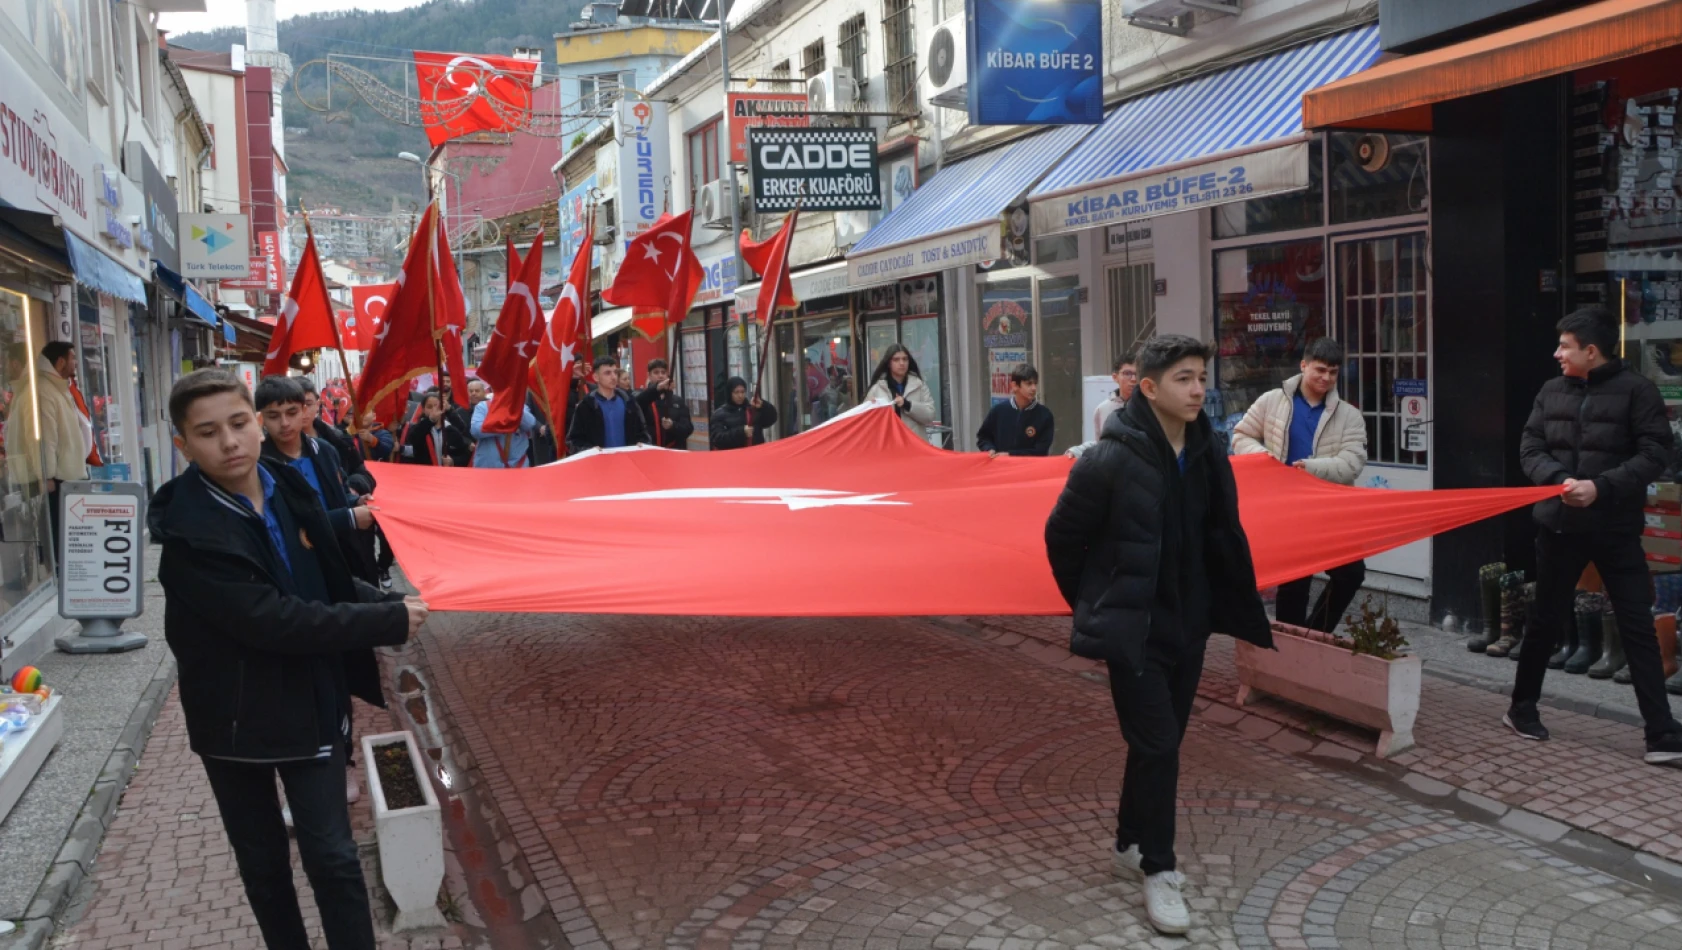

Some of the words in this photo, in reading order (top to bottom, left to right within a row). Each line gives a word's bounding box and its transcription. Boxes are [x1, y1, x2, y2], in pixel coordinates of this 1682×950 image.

[987, 47, 1035, 69] KİBAR
[1040, 49, 1080, 70] BÜFE
[1084, 53, 1094, 70] 2
[760, 144, 872, 170] CADDE
[762, 177, 806, 196] ERKEK
[809, 172, 873, 195] KUAFÖRÜ
[1067, 188, 1139, 217] KİBAR
[1145, 165, 1246, 200] BÜFE-2
[1064, 215, 1091, 227] TEKEL
[1121, 196, 1178, 216] KURUYEMİŞ
[1222, 186, 1236, 198] 23
[1238, 182, 1253, 195] 26
[186, 261, 205, 270] Türk
[208, 262, 245, 271] Telekom
[264, 235, 278, 290] ECZANE
[857, 262, 879, 277] CADDE
[921, 246, 941, 264] TOST
[943, 247, 949, 259] &
[951, 233, 988, 257] SANDVİÇ
[1247, 320, 1293, 333] KURUYEMİŞ
[1249, 312, 1271, 321] TEKEL
[103, 519, 131, 594] FOTO
